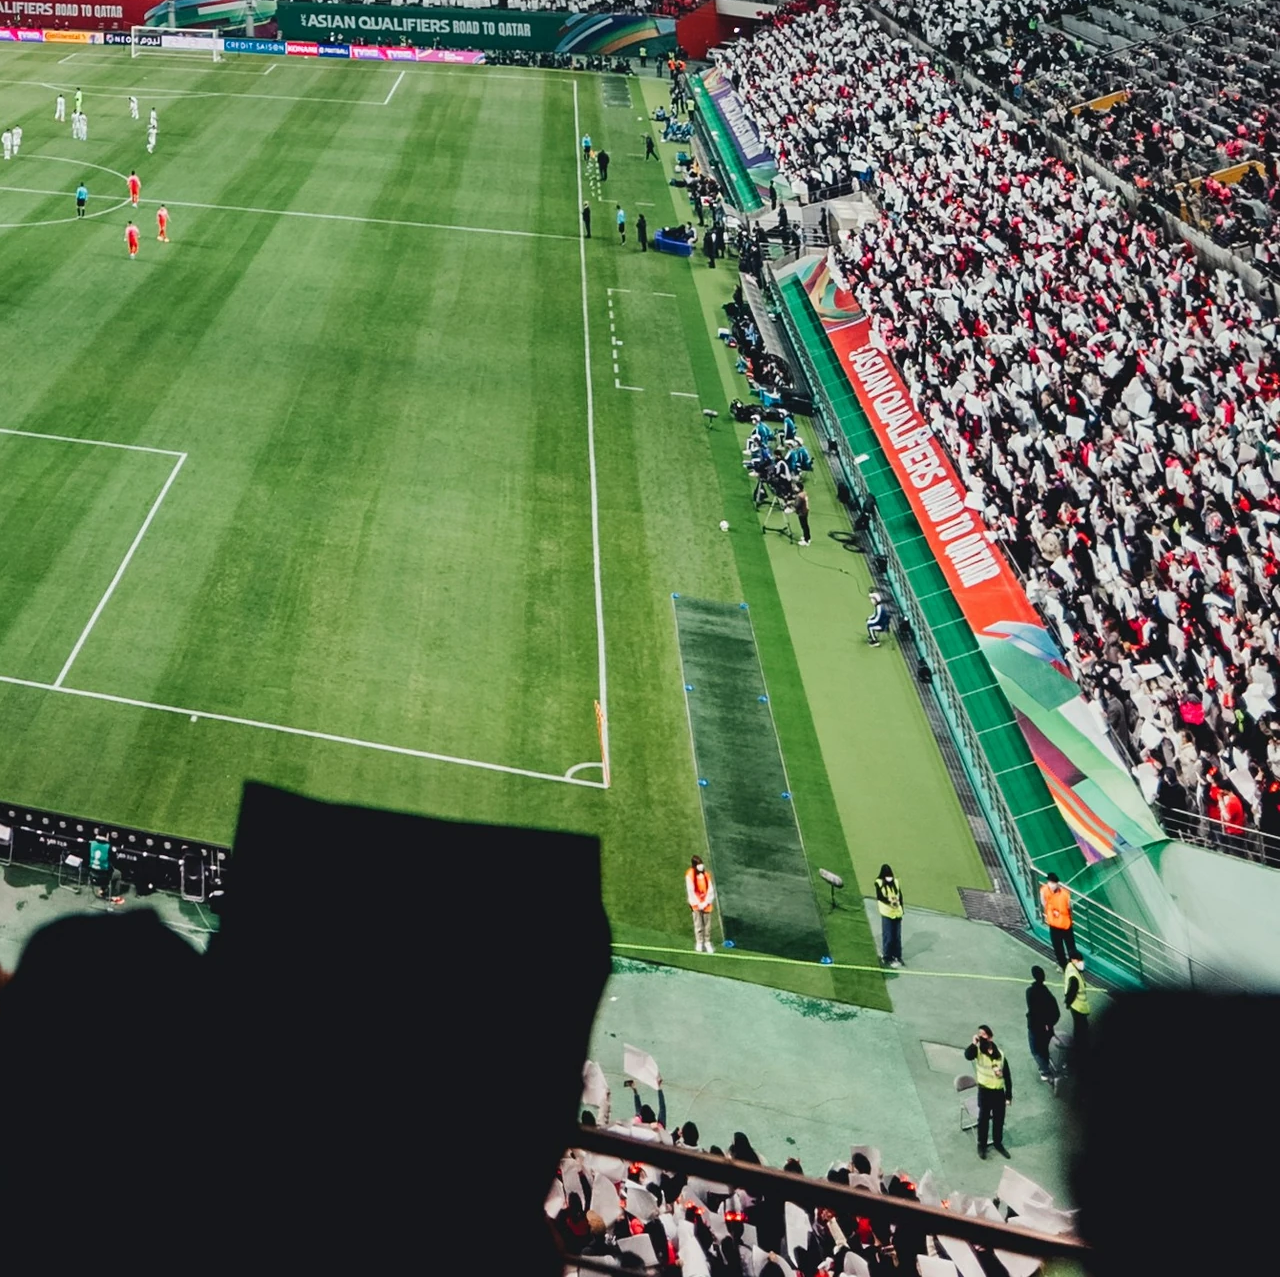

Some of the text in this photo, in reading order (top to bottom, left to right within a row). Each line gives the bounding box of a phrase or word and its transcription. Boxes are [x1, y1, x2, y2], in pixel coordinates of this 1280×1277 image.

[55, 3, 77, 16] ROAD
[81, 4, 92, 16] TO
[94, 5, 123, 18] QATAR
[45, 31, 82, 40] Continental
[307, 14, 356, 28] ASIAN
[358, 16, 451, 33] QUALIFIERS
[453, 20, 480, 35] ROAD
[482, 21, 495, 35] TO
[499, 22, 531, 37] QATAR
[225, 40, 284, 51] CREDIT SAISON
[287, 44, 317, 54] KONAMI
[852, 349, 896, 399] ASIAN
[873, 390, 947, 489] QUALIFIERS
[936, 512, 975, 541] TO
[944, 533, 1001, 588] QATAR
